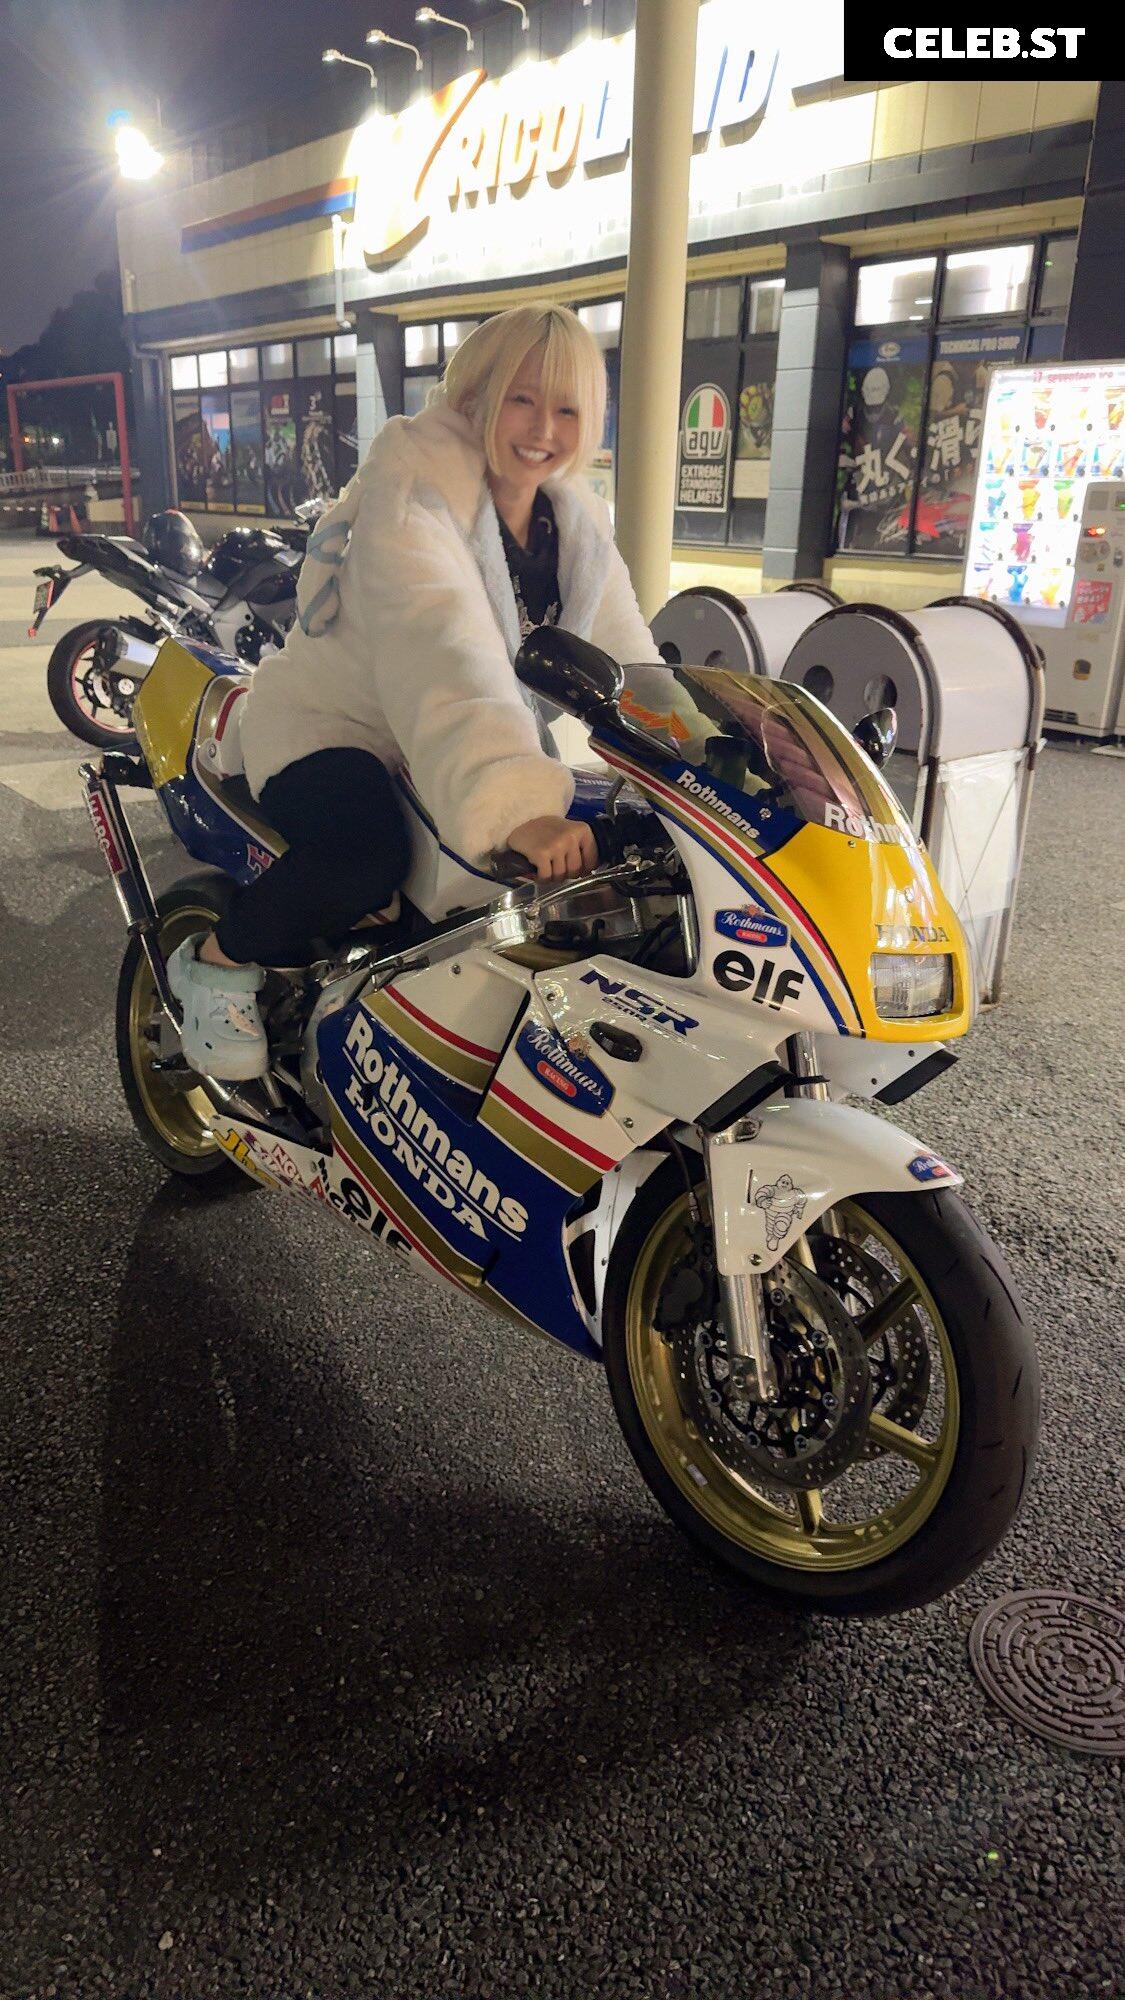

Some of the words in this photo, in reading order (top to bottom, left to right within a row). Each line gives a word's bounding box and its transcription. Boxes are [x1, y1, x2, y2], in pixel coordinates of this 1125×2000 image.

[688, 431, 722, 456] agv
[676, 769, 761, 840] Rothmans
[824, 801, 910, 844] Rothm
[721, 911, 785, 937] Rothmans
[579, 970, 700, 1036] NSR
[712, 949, 805, 1012] elf
[527, 1027, 604, 1098] Rothmans
[345, 1011, 529, 1233] Rothmans
[343, 1075, 491, 1242] HONDA
